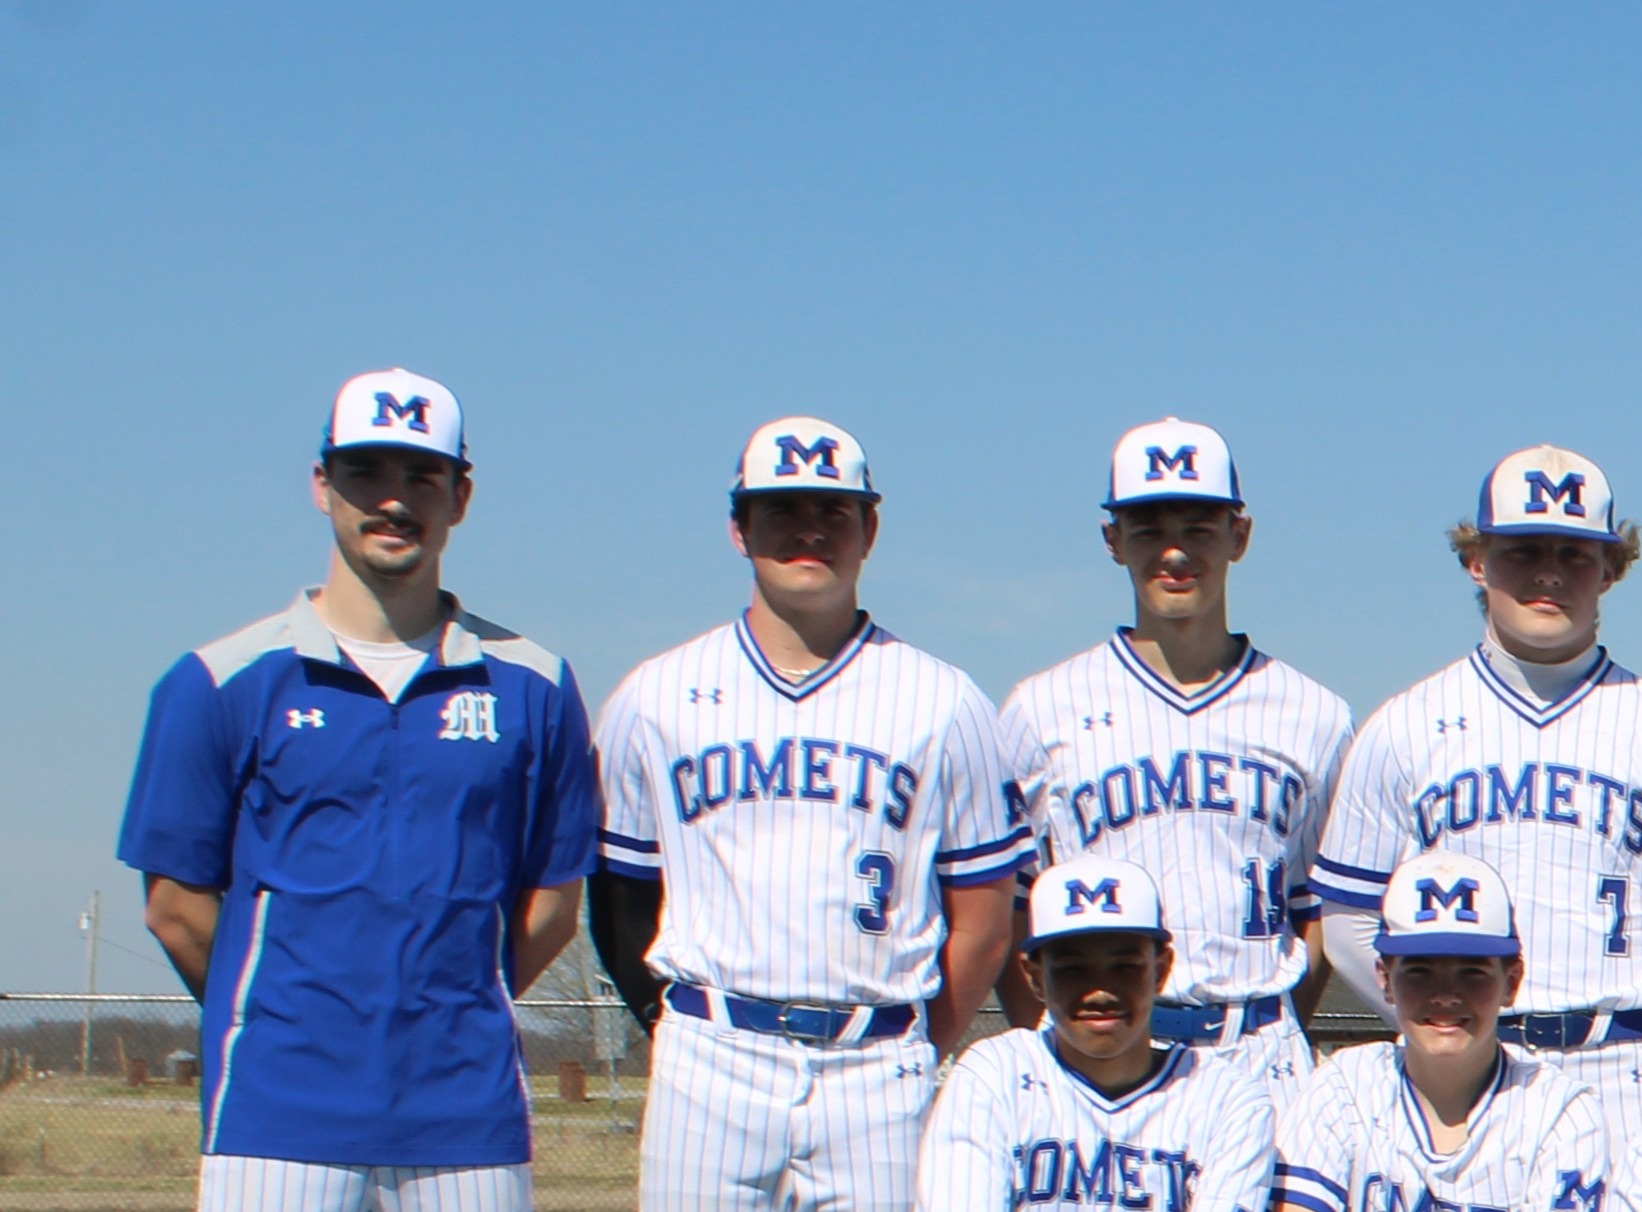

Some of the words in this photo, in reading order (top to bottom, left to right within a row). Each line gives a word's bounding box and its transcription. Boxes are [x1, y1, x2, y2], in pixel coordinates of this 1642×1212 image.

[371, 392, 430, 433] M
[776, 435, 840, 479] M
[1145, 446, 1198, 481] M
[1525, 471, 1585, 516] M
[439, 692, 500, 743] M
[672, 738, 918, 831] COMETS
[1072, 750, 1304, 848] COMETS
[854, 852, 896, 935] 3
[1065, 878, 1122, 914] M
[1415, 877, 1479, 923] M
[1598, 877, 1632, 956] 7
